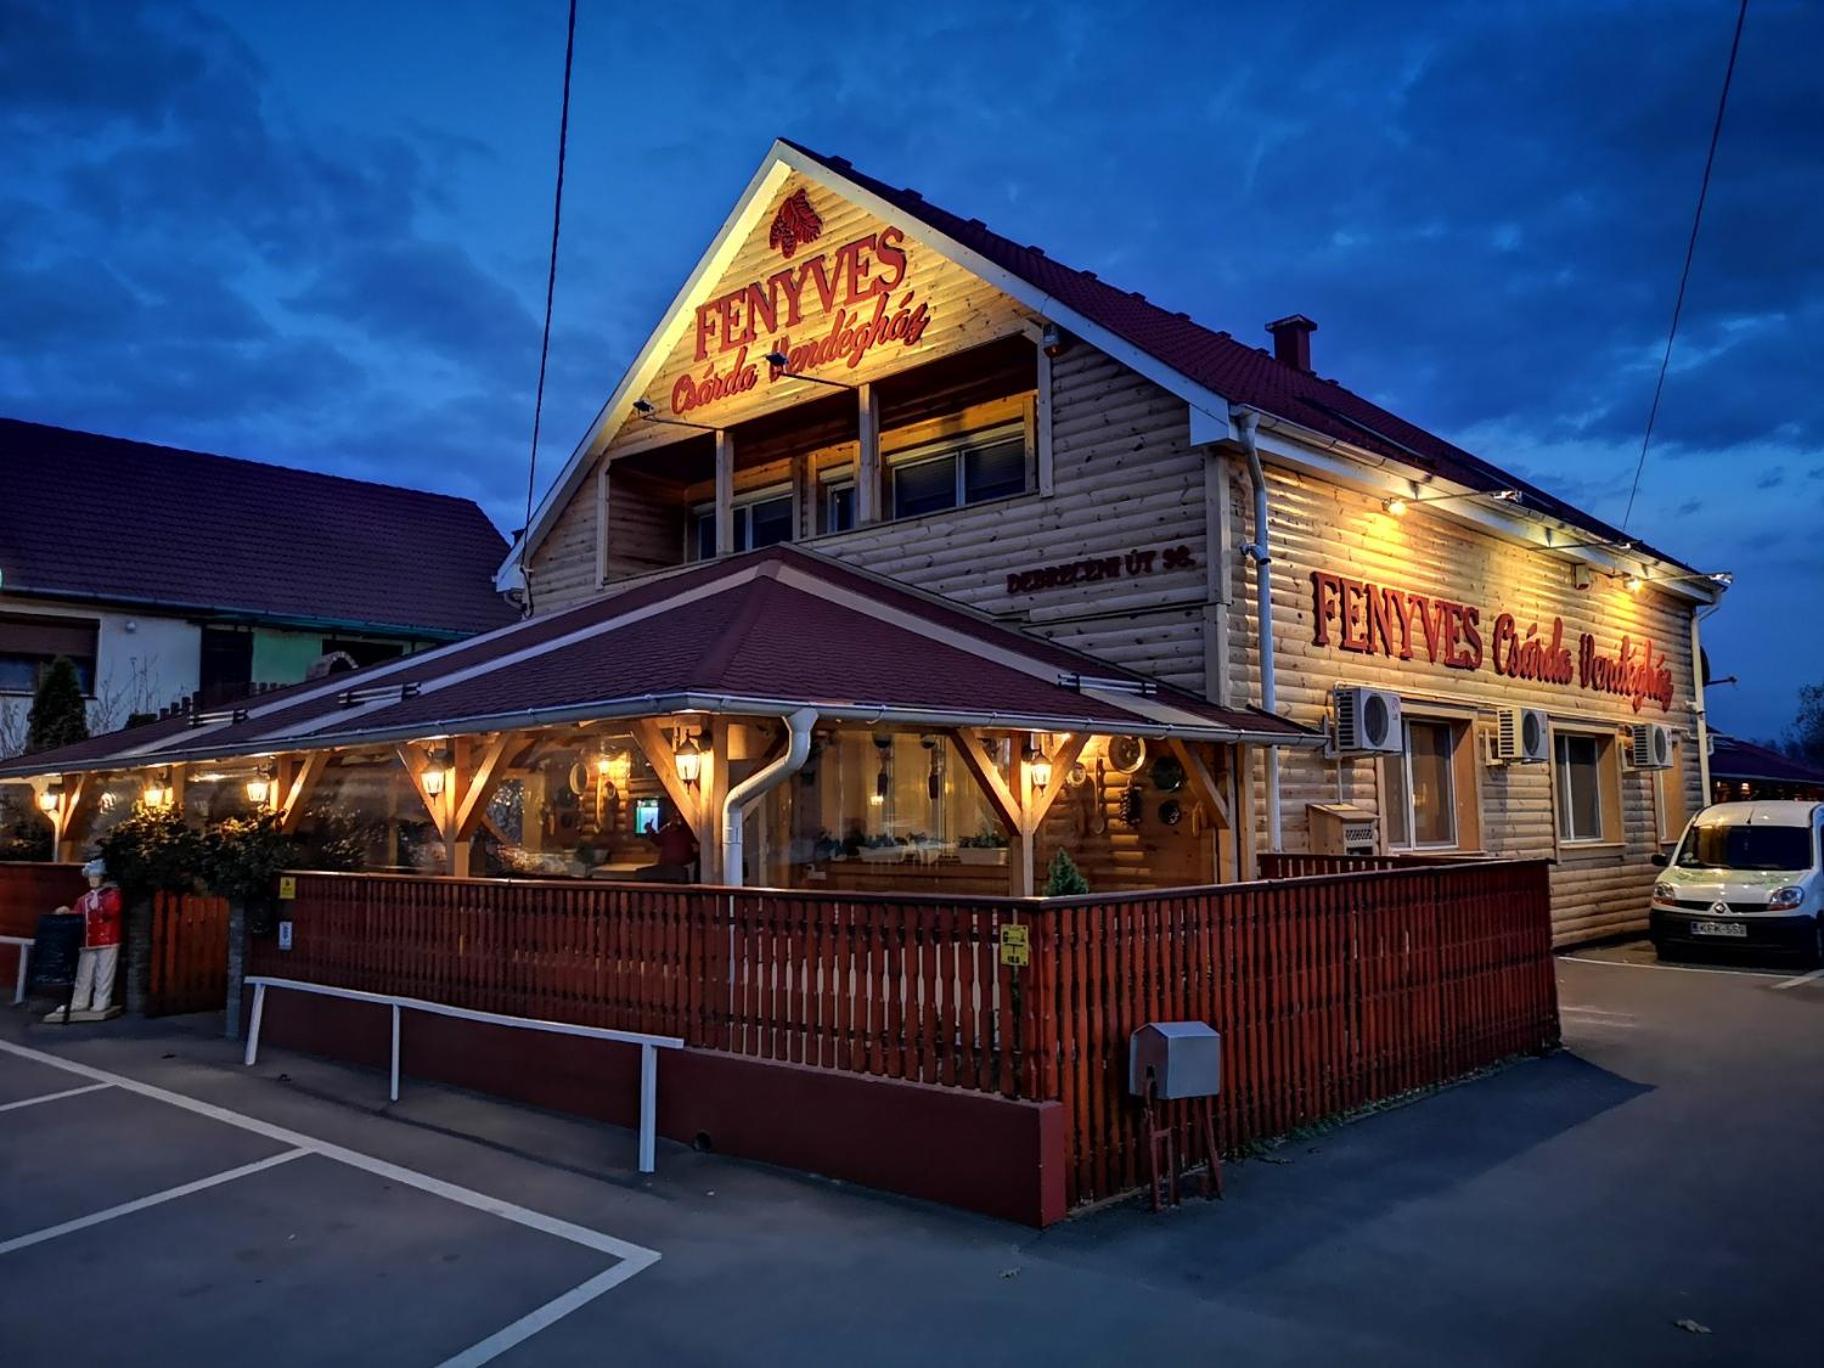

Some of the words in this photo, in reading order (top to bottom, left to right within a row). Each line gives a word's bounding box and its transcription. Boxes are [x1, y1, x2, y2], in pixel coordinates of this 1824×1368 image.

[693, 226, 908, 363] FENYVES
[671, 346, 757, 414] Csárda
[1310, 571, 1483, 671] FENYVES
[1492, 612, 1575, 685] Csárda
[1578, 633, 1675, 713] Vendégház
